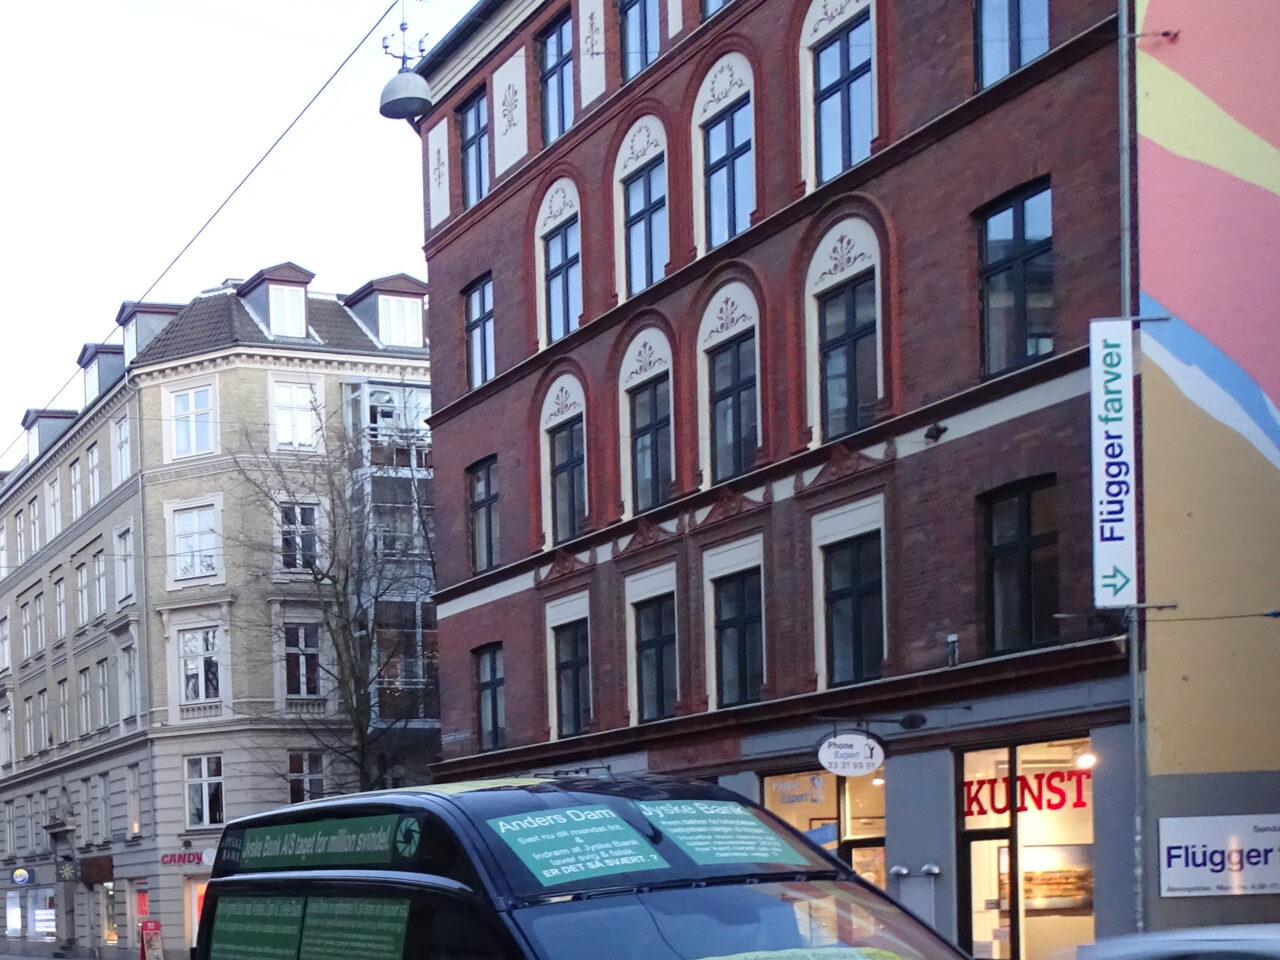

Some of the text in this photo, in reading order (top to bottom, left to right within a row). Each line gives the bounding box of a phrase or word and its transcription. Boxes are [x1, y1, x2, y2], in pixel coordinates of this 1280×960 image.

[1098, 339, 1130, 543] Flügger farver
[827, 741, 854, 750] Phone
[964, 769, 1092, 817] KUNST
[640, 802, 750, 818] Jyske Bank
[498, 808, 617, 833] Anders Dam
[161, 852, 203, 865] CANDY
[1166, 844, 1274, 873] Flügger
[542, 868, 561, 878] ER
[560, 863, 585, 874] DET
